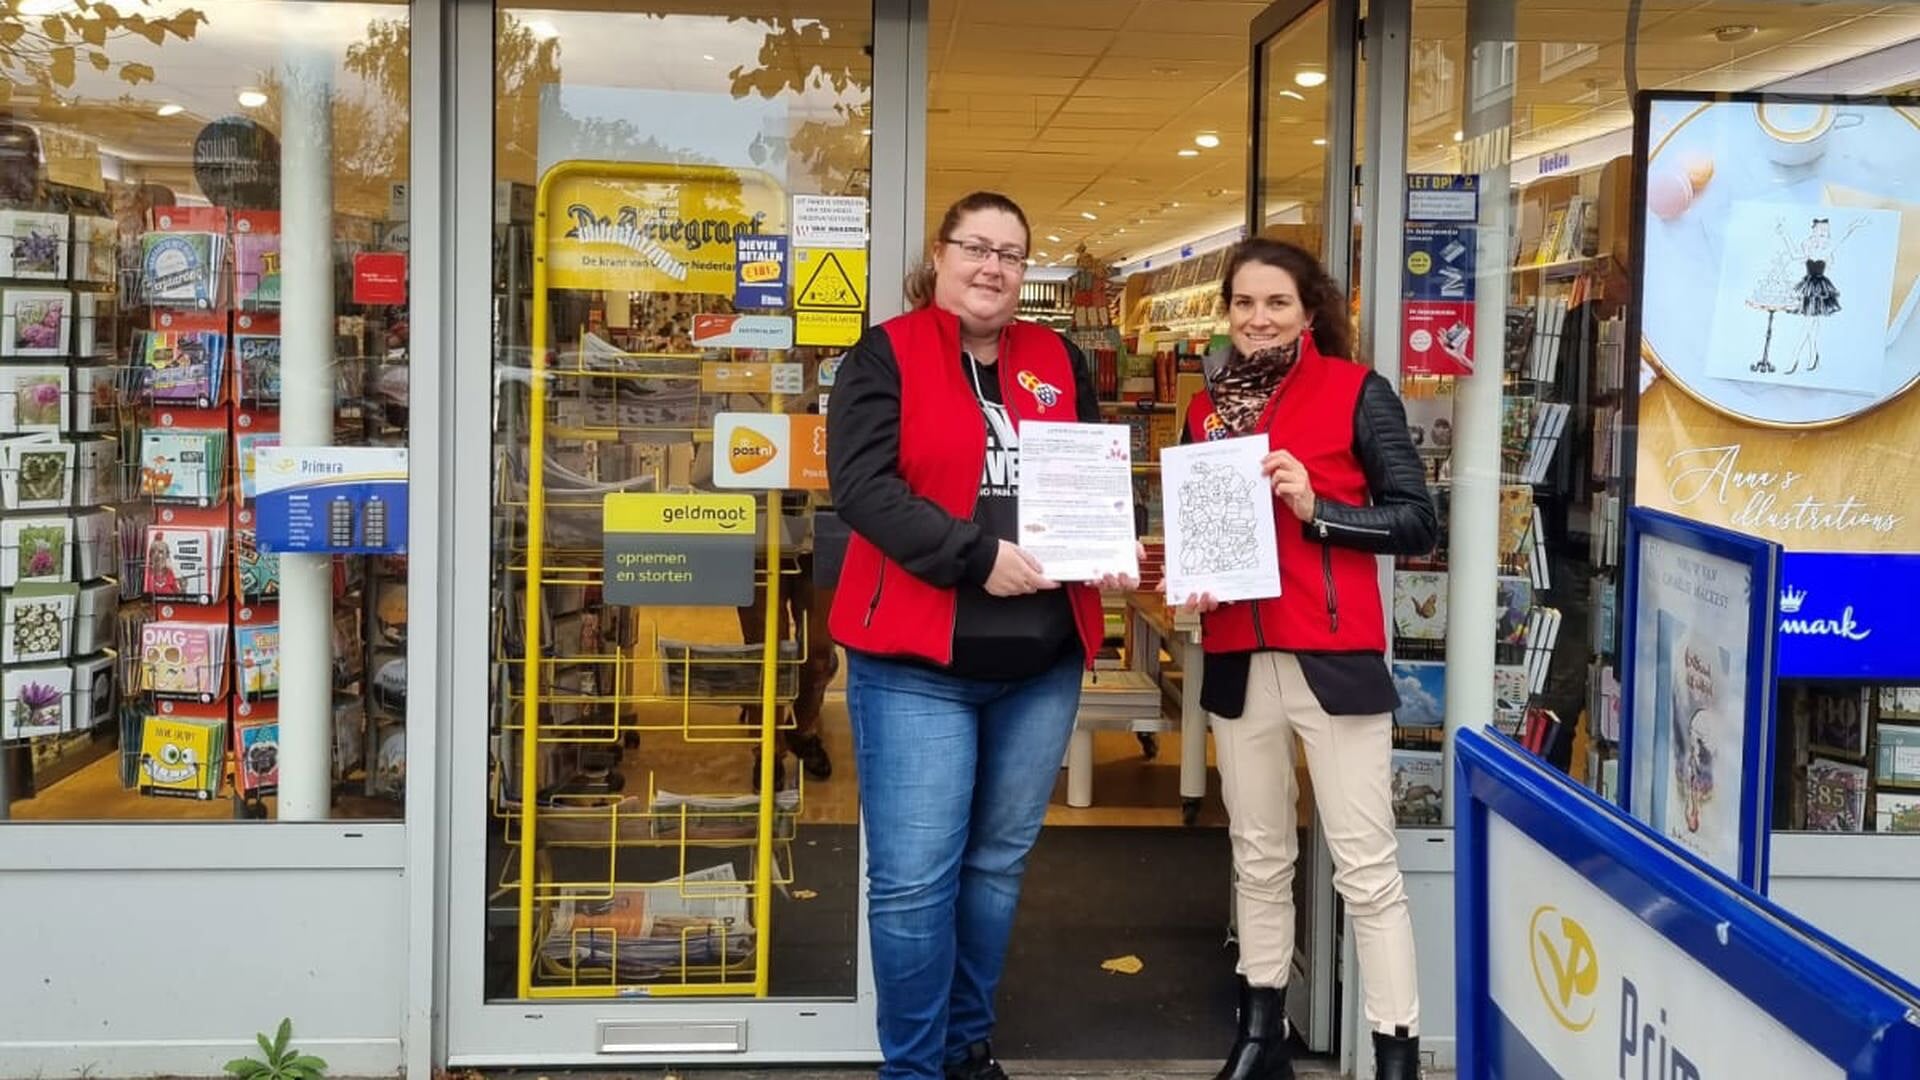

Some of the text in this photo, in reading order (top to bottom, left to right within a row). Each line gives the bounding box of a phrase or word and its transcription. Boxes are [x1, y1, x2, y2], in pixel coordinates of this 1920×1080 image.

[1409, 175, 1427, 189] LET
[738, 240, 778, 251] DIEVEN
[582, 255, 597, 267] De
[738, 251, 783, 262] BETALEN
[302, 459, 344, 474] Primera
[663, 506, 747, 523] geldmaat
[616, 553, 687, 567] opnemen
[616, 569, 693, 582] en storten
[143, 629, 187, 647] OMG
[1818, 783, 1846, 808] 85
